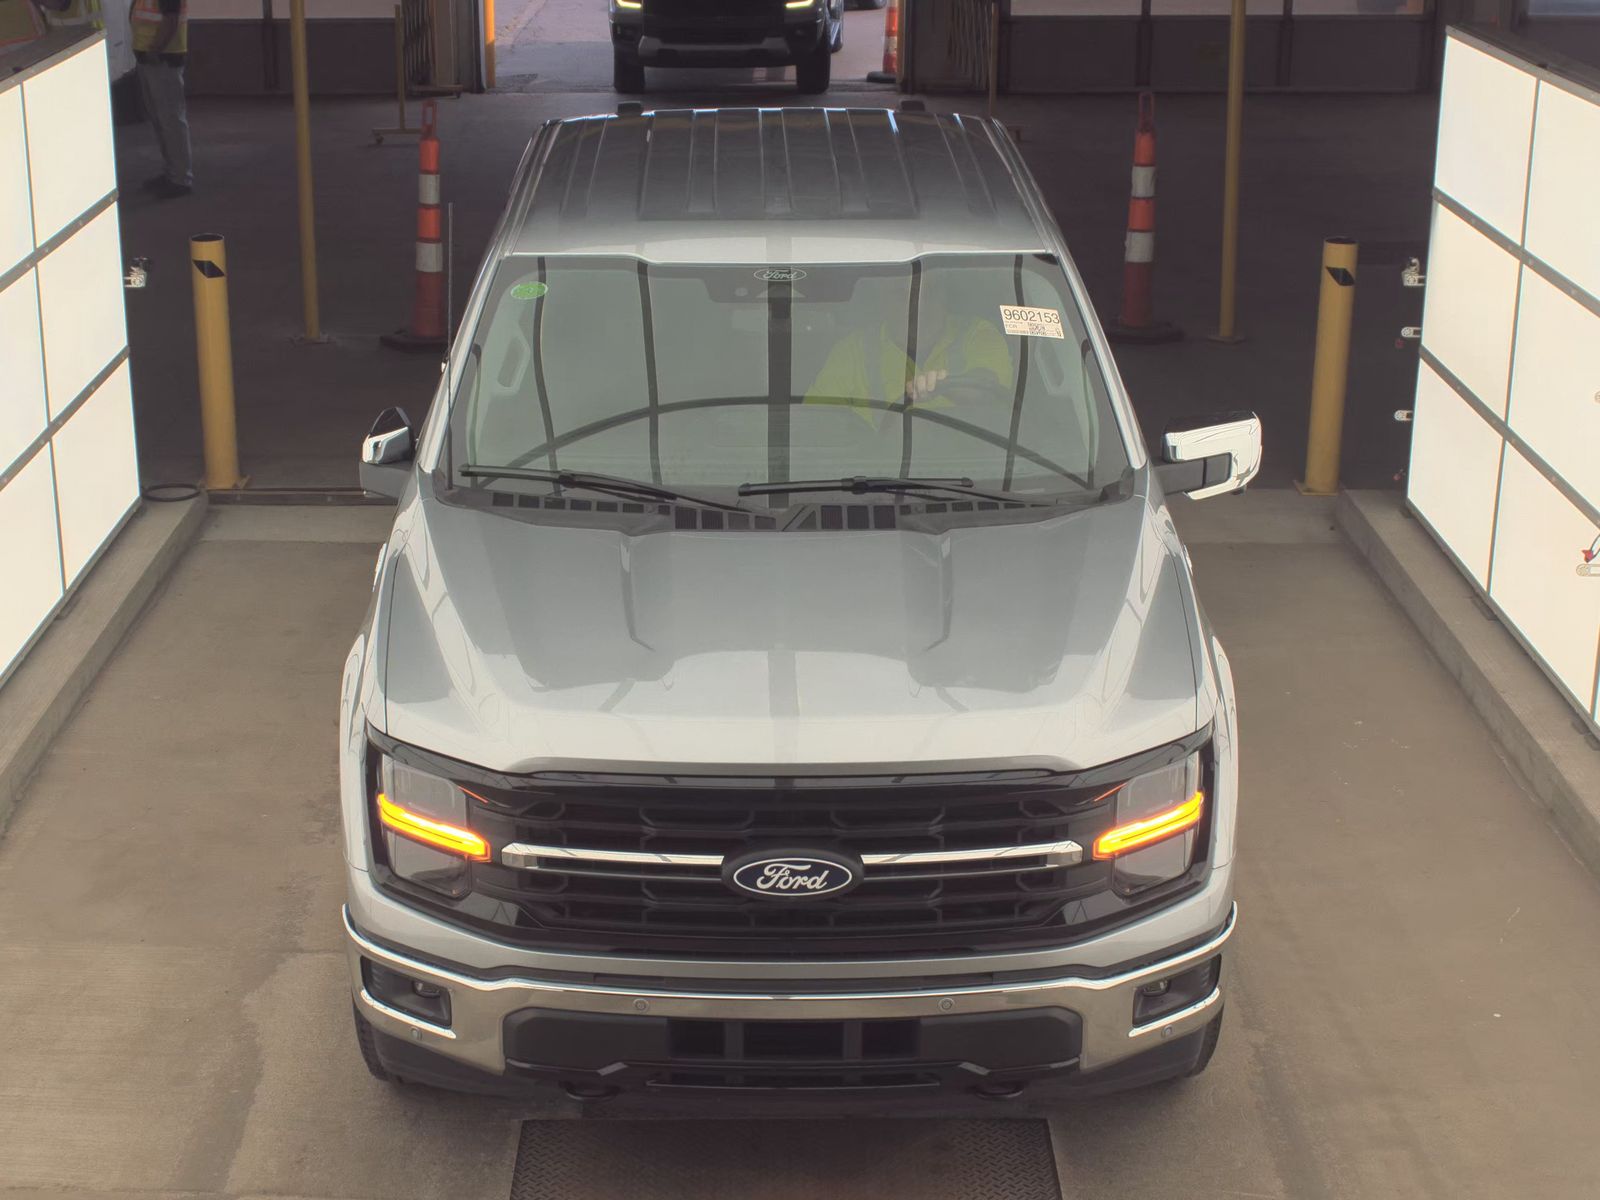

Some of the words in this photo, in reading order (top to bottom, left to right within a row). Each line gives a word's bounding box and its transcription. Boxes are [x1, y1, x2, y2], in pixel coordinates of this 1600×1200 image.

[763, 269, 798, 279] Ford
[1003, 308, 1060, 324] 9602153
[756, 863, 830, 889] Ford
